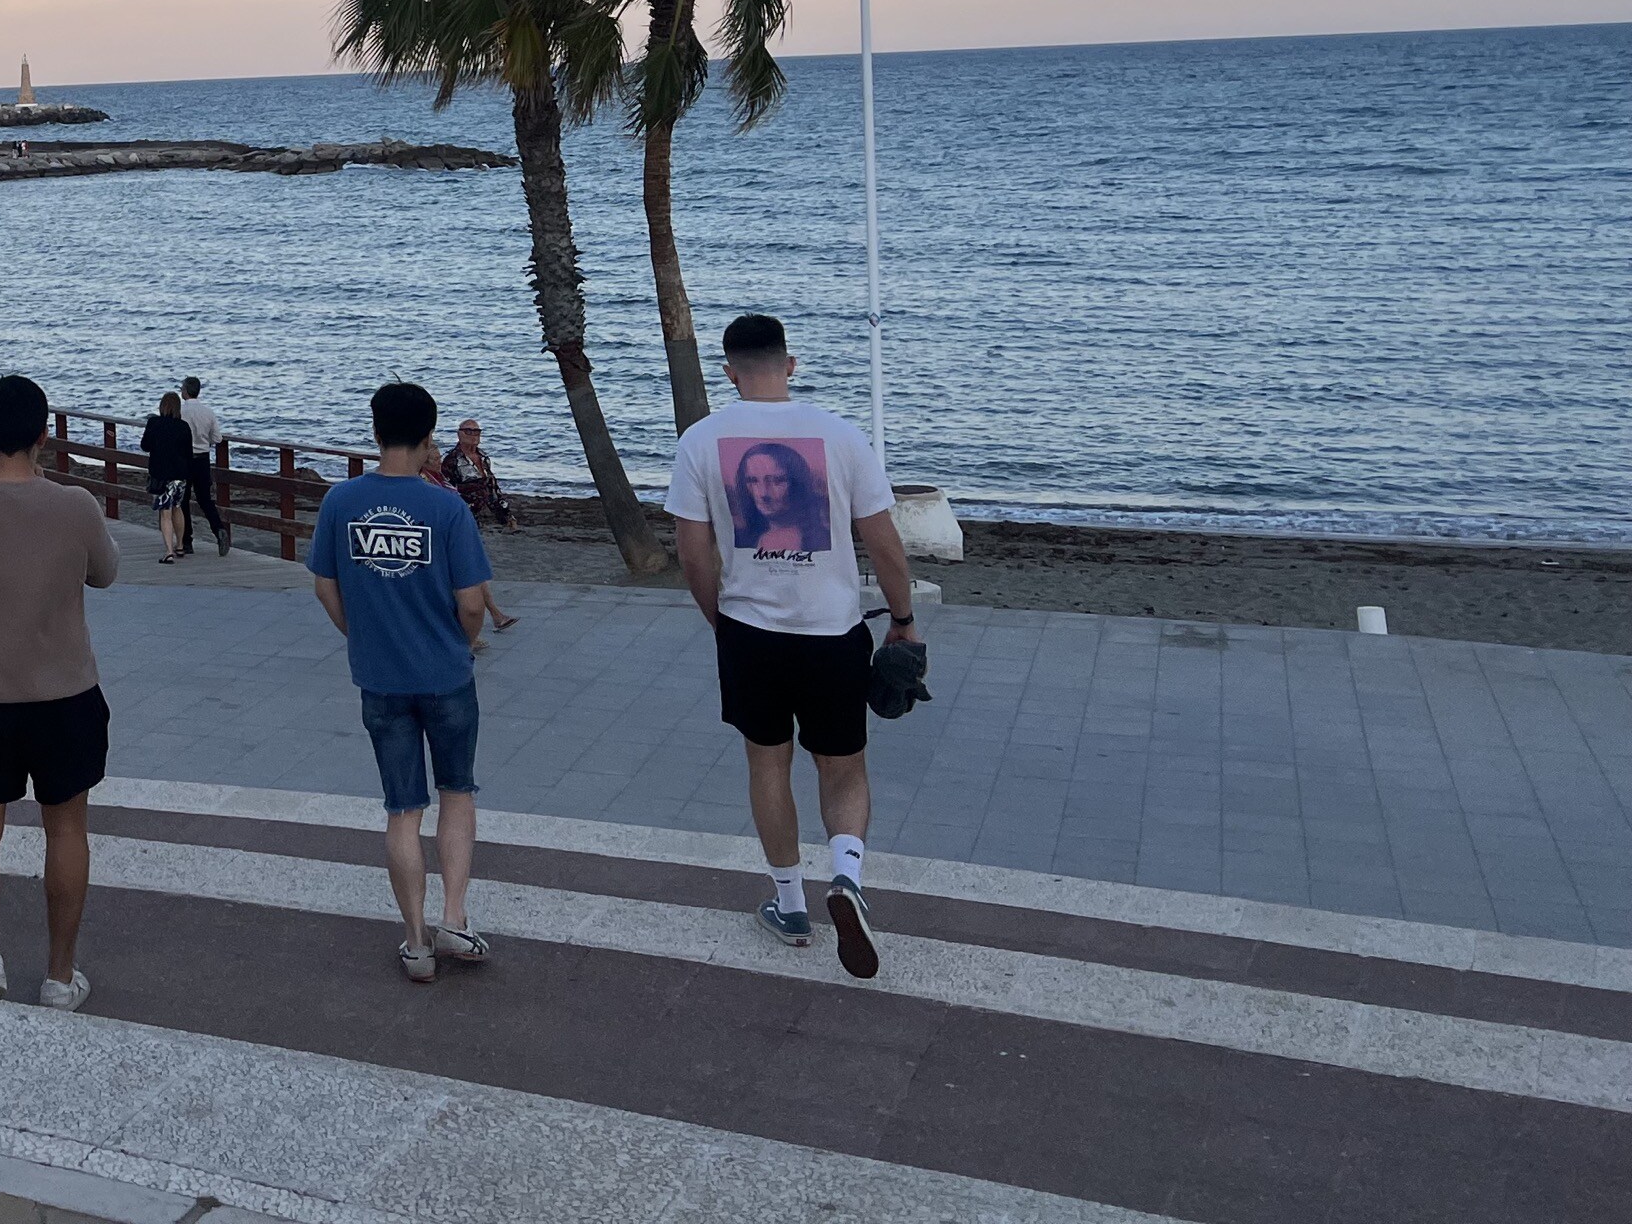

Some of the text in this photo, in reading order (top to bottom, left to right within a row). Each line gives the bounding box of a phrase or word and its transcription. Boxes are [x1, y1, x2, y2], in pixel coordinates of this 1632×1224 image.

[359, 505, 415, 525] THE ORIGINAL
[355, 528, 423, 557] VANS
